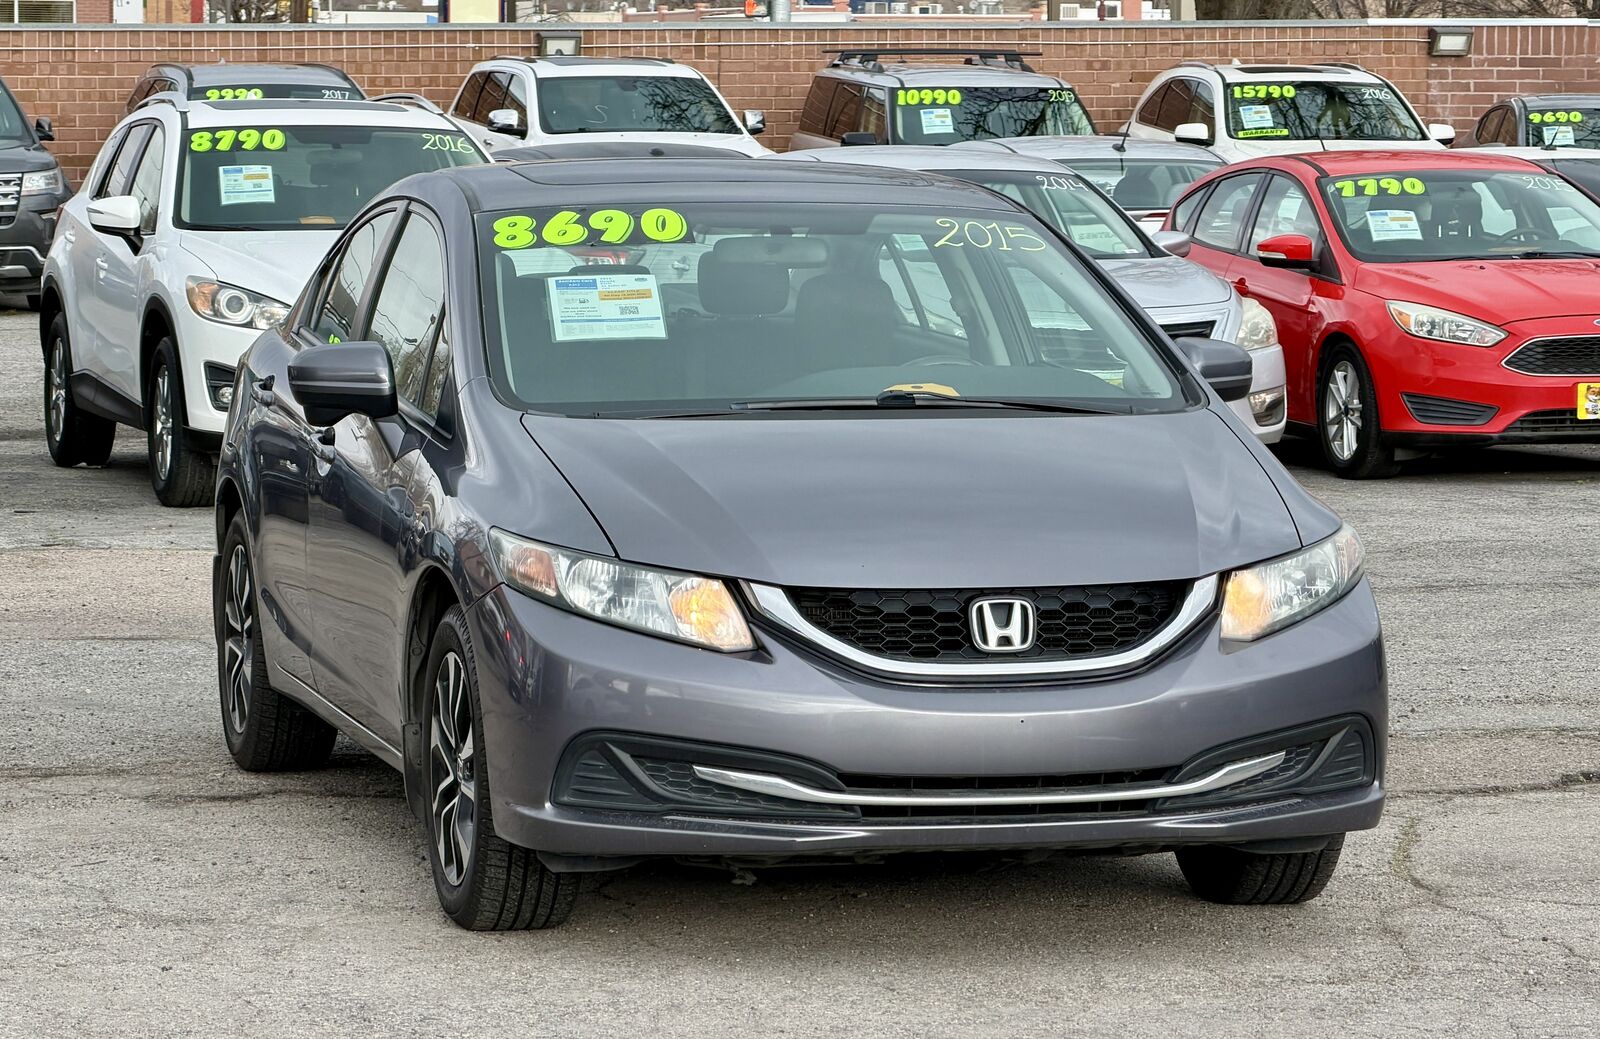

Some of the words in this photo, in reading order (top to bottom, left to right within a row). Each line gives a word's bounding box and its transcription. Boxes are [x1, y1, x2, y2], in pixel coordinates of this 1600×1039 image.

[321, 89, 350, 100] 2017
[897, 89, 961, 105] 10990
[1233, 85, 1297, 98] 15790
[1361, 88, 1391, 100] 2016
[1528, 111, 1582, 124] 9690
[190, 129, 286, 152] 8790
[1243, 129, 1284, 137] WARRANTY
[421, 133, 475, 154] 2016
[1035, 175, 1089, 192] 2014
[1335, 177, 1425, 197] 7790
[1522, 176, 1575, 193] 2015
[493, 208, 688, 249] 8690
[934, 218, 1046, 251] 2015
